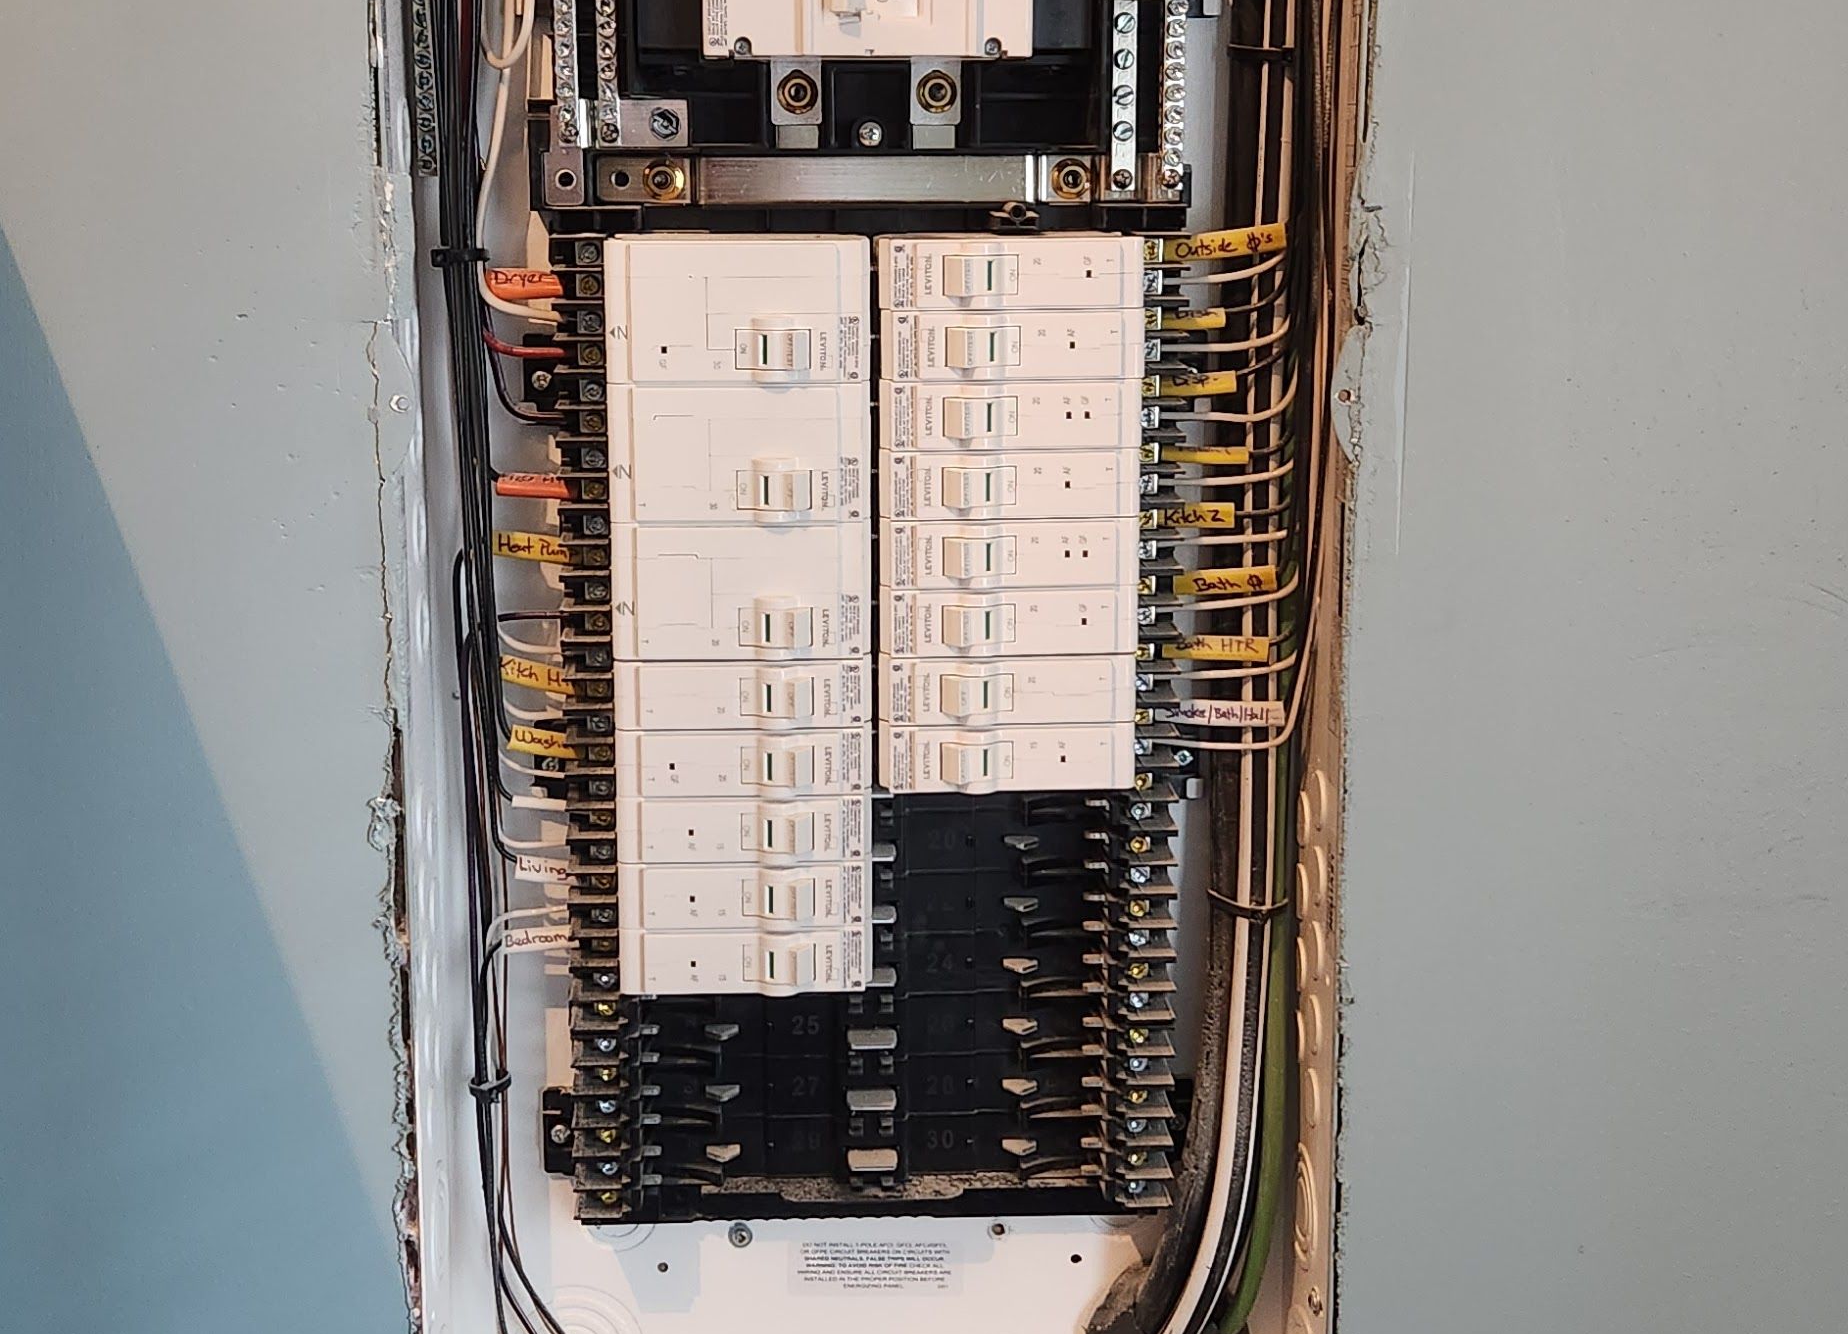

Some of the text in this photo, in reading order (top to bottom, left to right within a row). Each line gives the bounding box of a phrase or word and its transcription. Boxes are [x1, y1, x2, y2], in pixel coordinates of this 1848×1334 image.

[1175, 238, 1239, 259] Outside
[494, 271, 546, 288] Dryer
[819, 331, 827, 371] LEVITON
[927, 326, 935, 367] LEVITON
[925, 395, 933, 436] LEVITON
[820, 471, 829, 511] LEVITON
[1164, 509, 1207, 525] Kitch
[498, 533, 534, 555] Heat
[925, 535, 933, 576] LEVITON
[1192, 577, 1241, 592] Bath
[821, 608, 830, 648] LEVITON
[924, 603, 932, 644] LEVITON
[1221, 638, 1259, 654] HTR
[500, 656, 539, 682] Kitch
[823, 678, 832, 718] LEVITON
[519, 856, 568, 881] Living
[504, 930, 569, 947] Bedroom
[791, 1016, 820, 1035] 25
